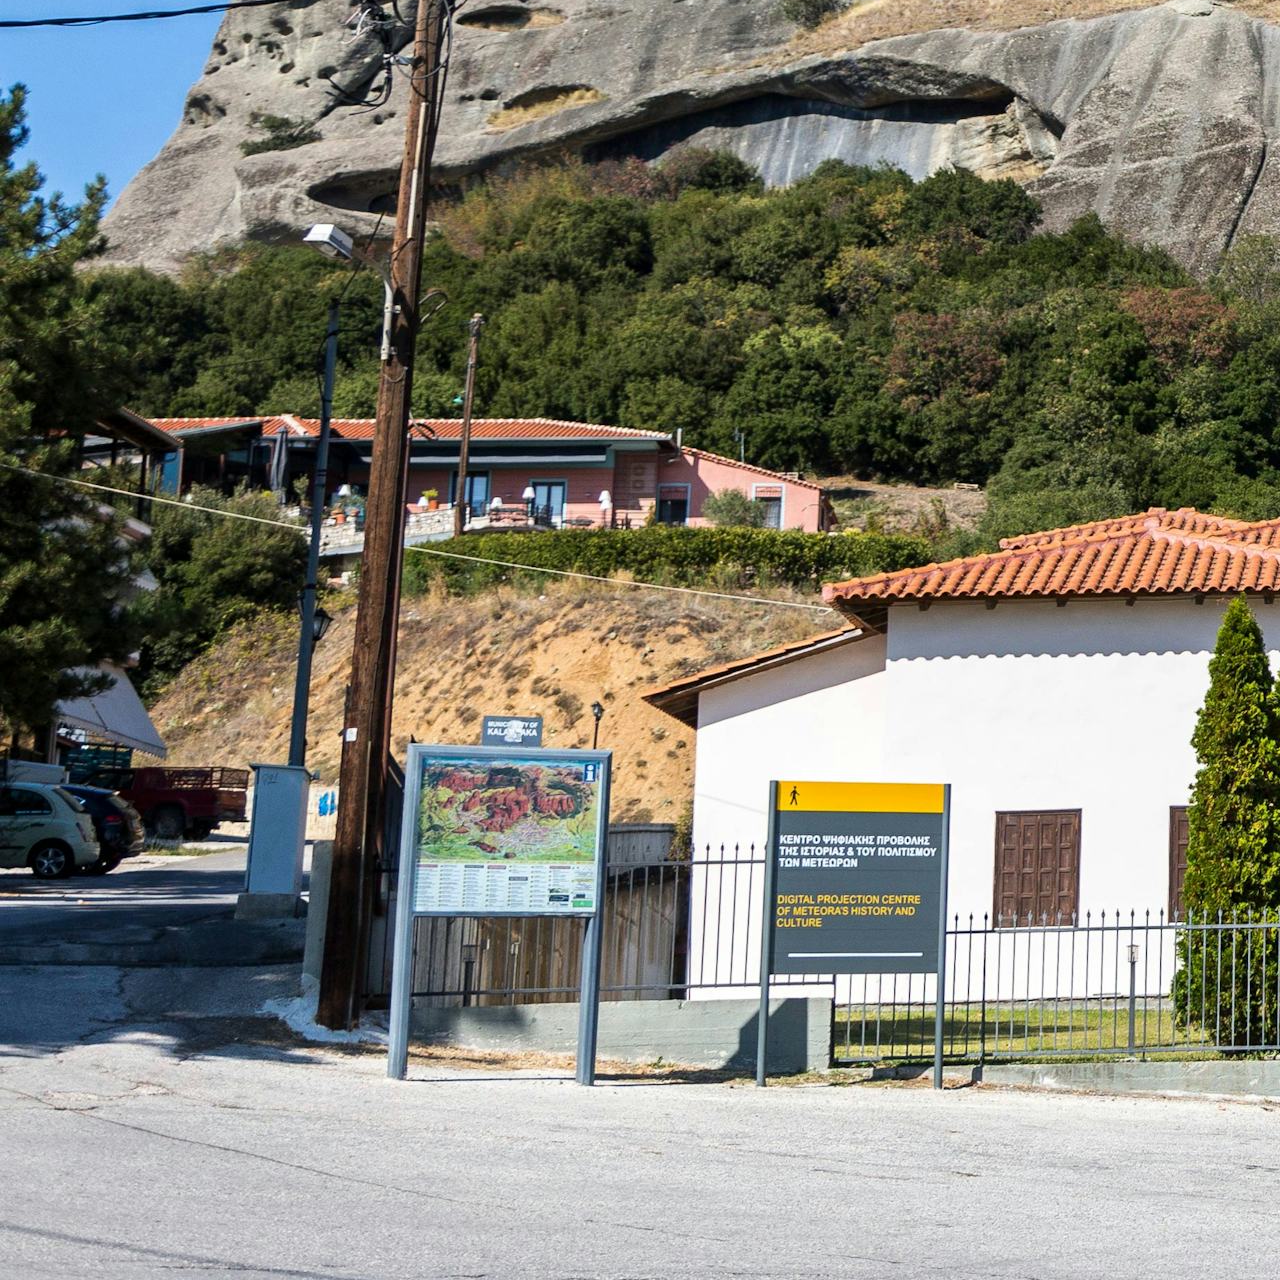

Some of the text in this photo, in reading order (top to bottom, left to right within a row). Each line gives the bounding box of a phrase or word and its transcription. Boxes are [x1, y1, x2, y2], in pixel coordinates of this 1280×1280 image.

[487, 727, 537, 736] KALAAKA
[780, 835, 930, 845] ΚΕΝΤΡΟ ΨΗΦΙΑΚΗΣ ΠΡΟΒΟΛΗΣ
[779, 846, 937, 857] ΤΗΣ ΙΣΤΟΡΙΑΣ & ΤΟΥ ΠΟΛΙΤΙΣΜΟΥ
[779, 858, 858, 867] ΤΩΝ ΜΕΤΕΩΡΩΝ
[777, 895, 921, 904] DIGITAL PROJECTION CENTRE
[777, 906, 915, 916] OF METEORA'S HISTORY AND
[776, 918, 822, 928] CULTURE
